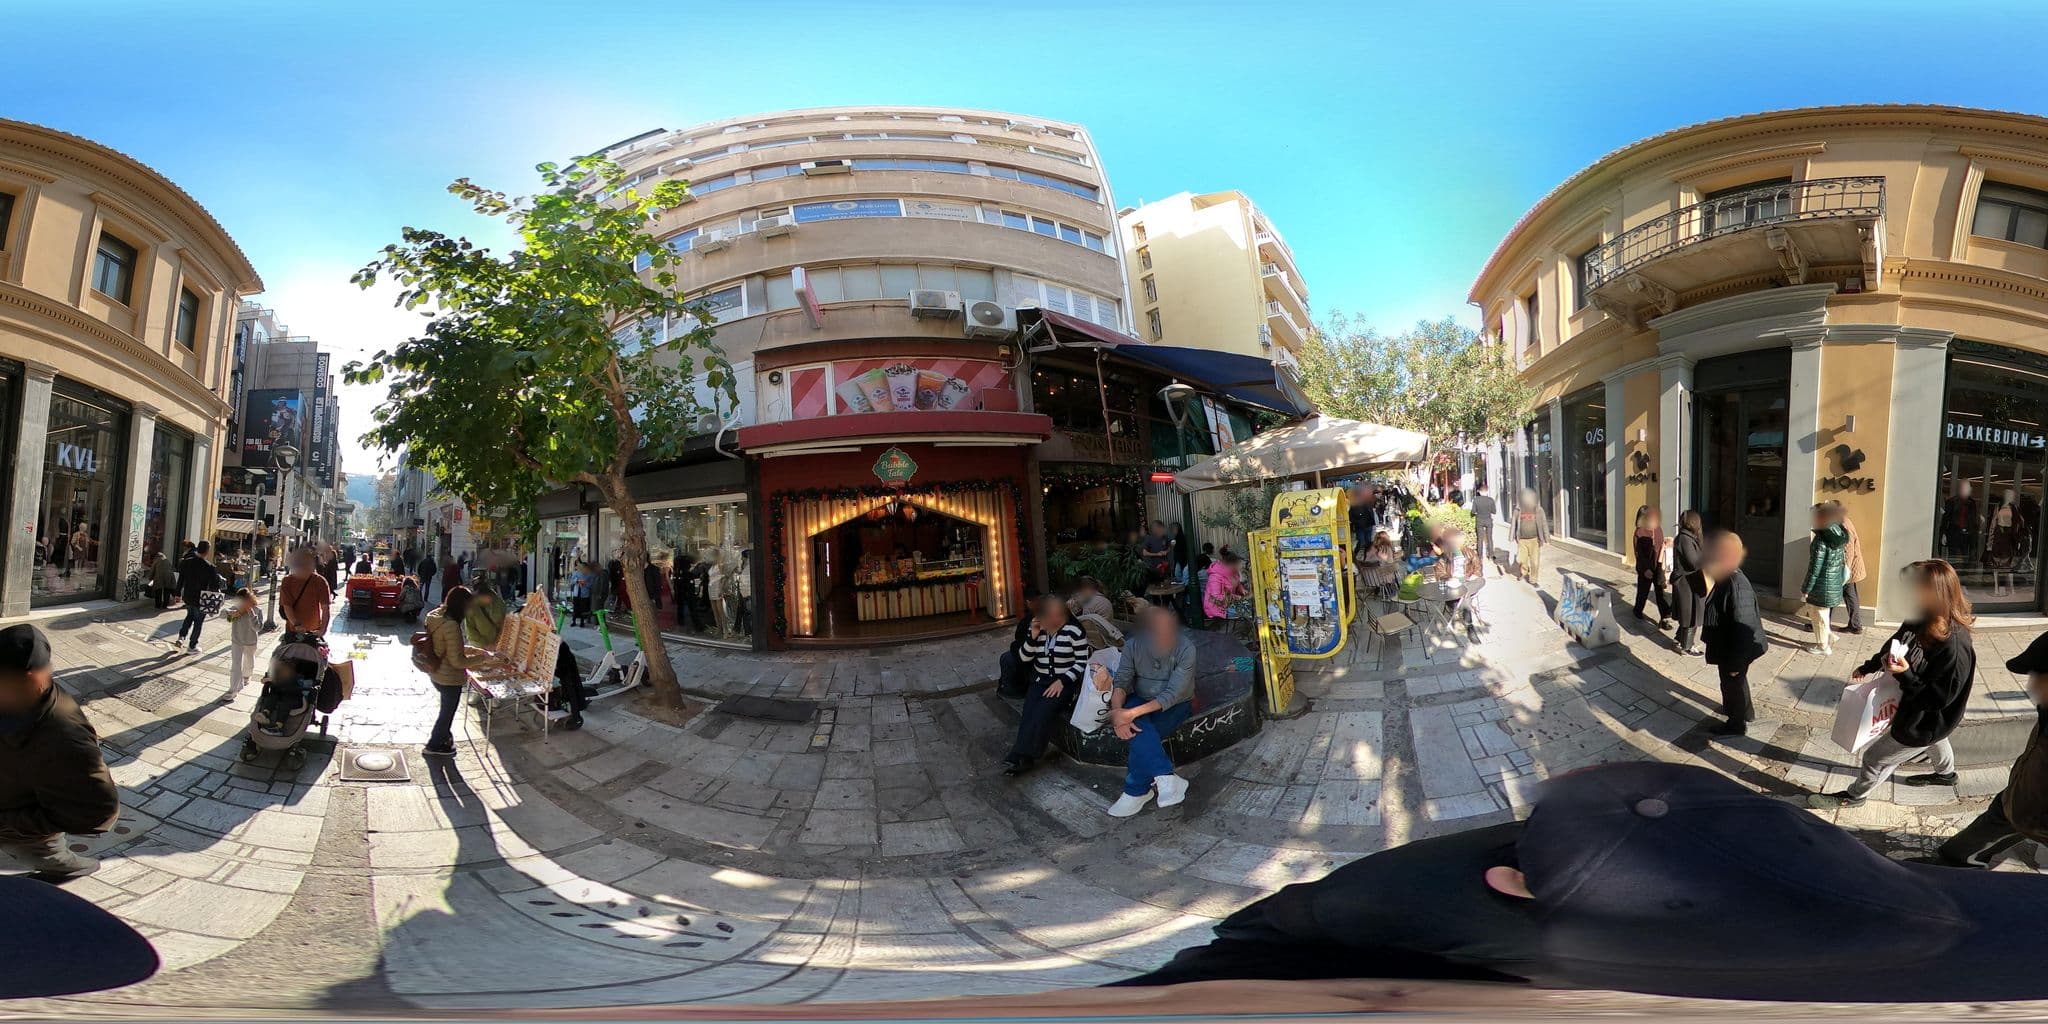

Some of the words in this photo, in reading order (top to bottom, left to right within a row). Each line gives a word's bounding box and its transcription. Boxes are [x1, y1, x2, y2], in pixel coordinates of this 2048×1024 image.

[317, 355, 326, 388] COSMOS
[1947, 423, 2028, 447] BRAKEBURN
[57, 443, 97, 473] KVL
[880, 461, 909, 469] Bubble
[887, 469, 903, 478] Tale
[1629, 472, 1657, 482] MOVE
[1822, 475, 1875, 492] MOVE
[218, 496, 256, 506] OSMOS
[1872, 703, 1899, 727] MIN
